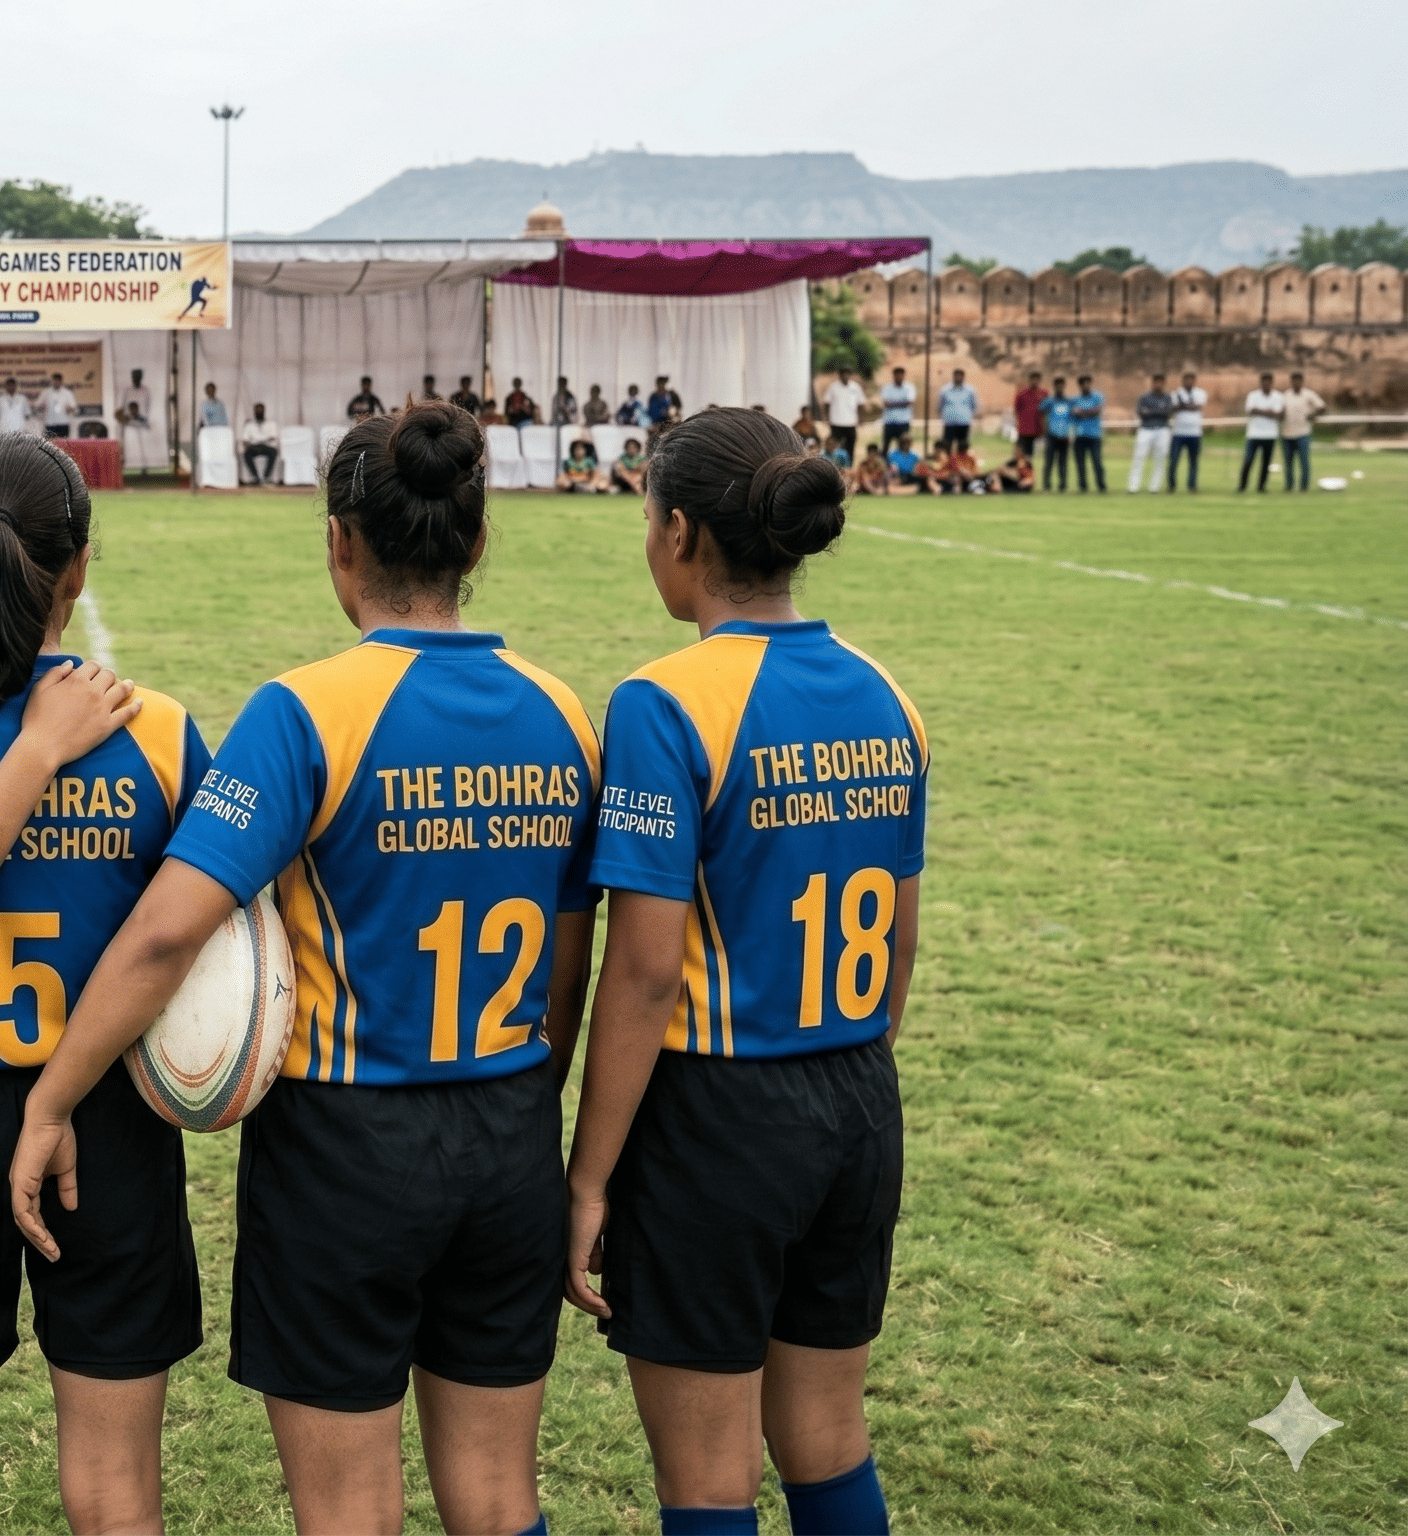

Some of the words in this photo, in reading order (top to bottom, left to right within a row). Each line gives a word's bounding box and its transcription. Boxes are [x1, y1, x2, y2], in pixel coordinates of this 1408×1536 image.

[67, 252, 182, 272] FEDERATION
[18, 281, 160, 303] CHAMPIONSHIP
[749, 743, 808, 789] THE
[812, 737, 914, 782] BOHRAS
[217, 774, 259, 810] LEVEL
[377, 767, 445, 811] THE
[454, 765, 580, 807] BOHRAS
[629, 790, 675, 816] LEVEL
[598, 808, 676, 839] TICIPANTS
[750, 791, 840, 830] GLOBAL
[21, 827, 136, 860] SCHOOL
[377, 816, 480, 853] GLOBAL
[487, 815, 573, 849] SCHOOL
[792, 866, 896, 1028] 18
[418, 897, 546, 1062] 12
